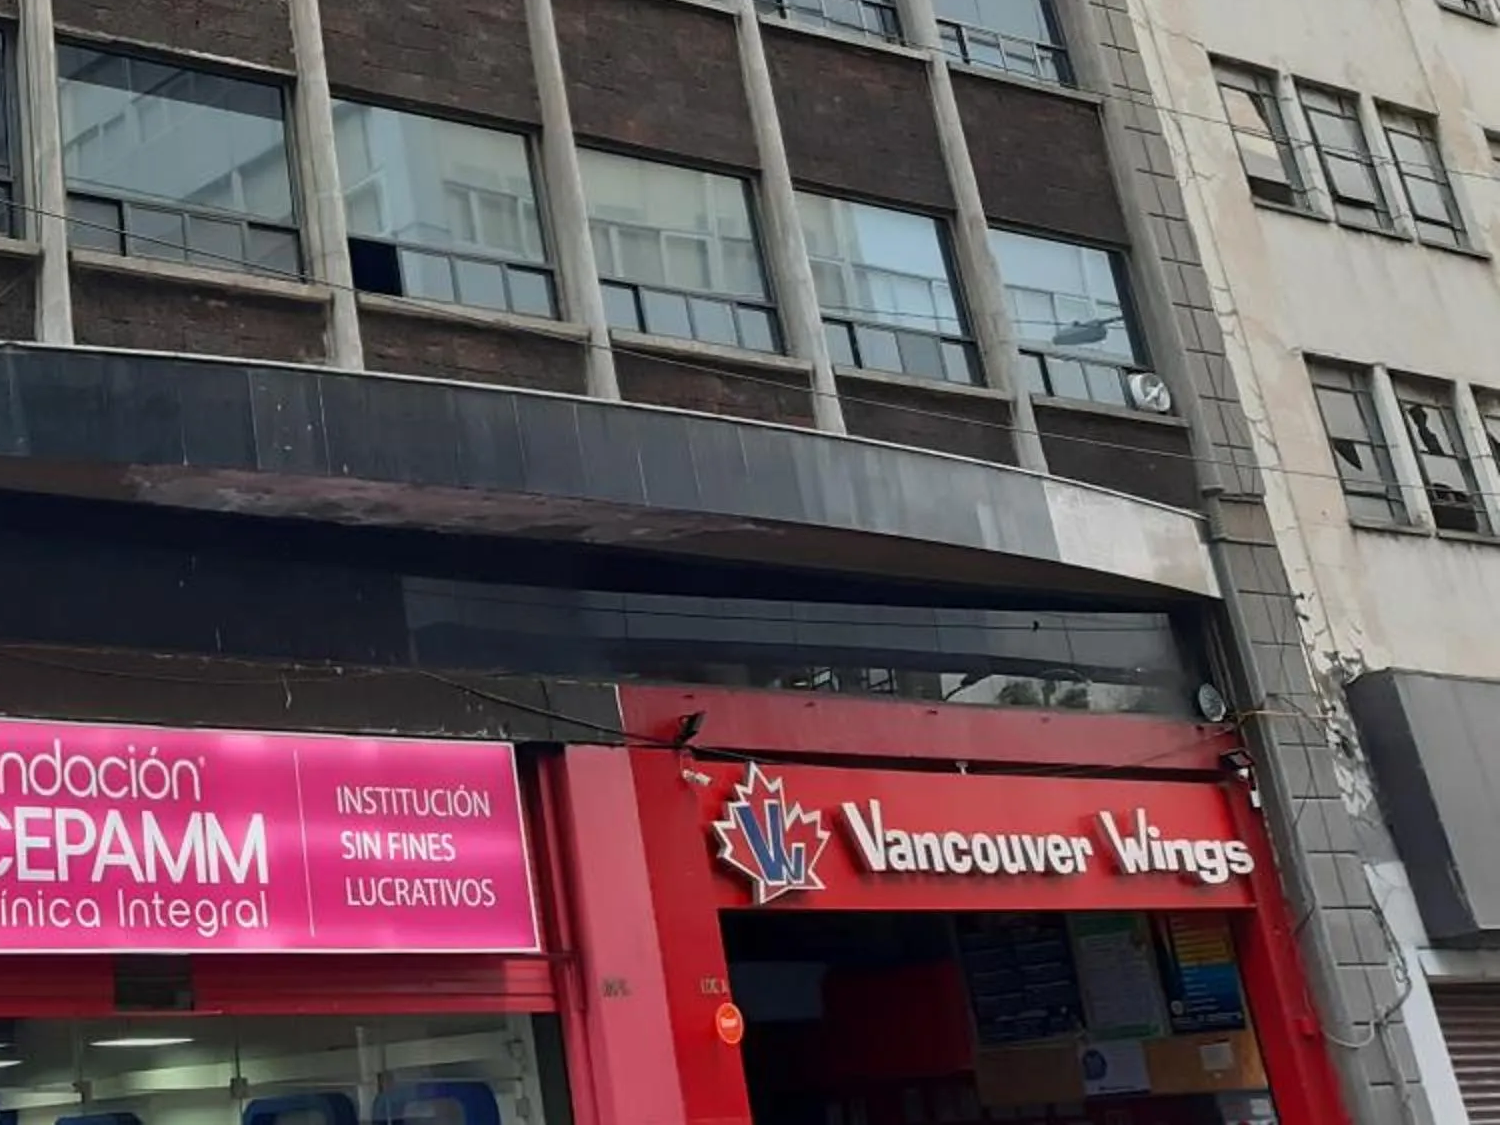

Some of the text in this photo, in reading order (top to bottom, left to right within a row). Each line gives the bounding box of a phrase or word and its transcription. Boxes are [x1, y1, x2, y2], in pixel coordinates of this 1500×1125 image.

[334, 783, 493, 820] INSTITUCIÓN
[340, 831, 457, 863] SIN FINES
[841, 797, 1255, 883] Vancouver Wings
[344, 877, 497, 909] LUCRATIVOS
[117, 889, 270, 939] Integral
